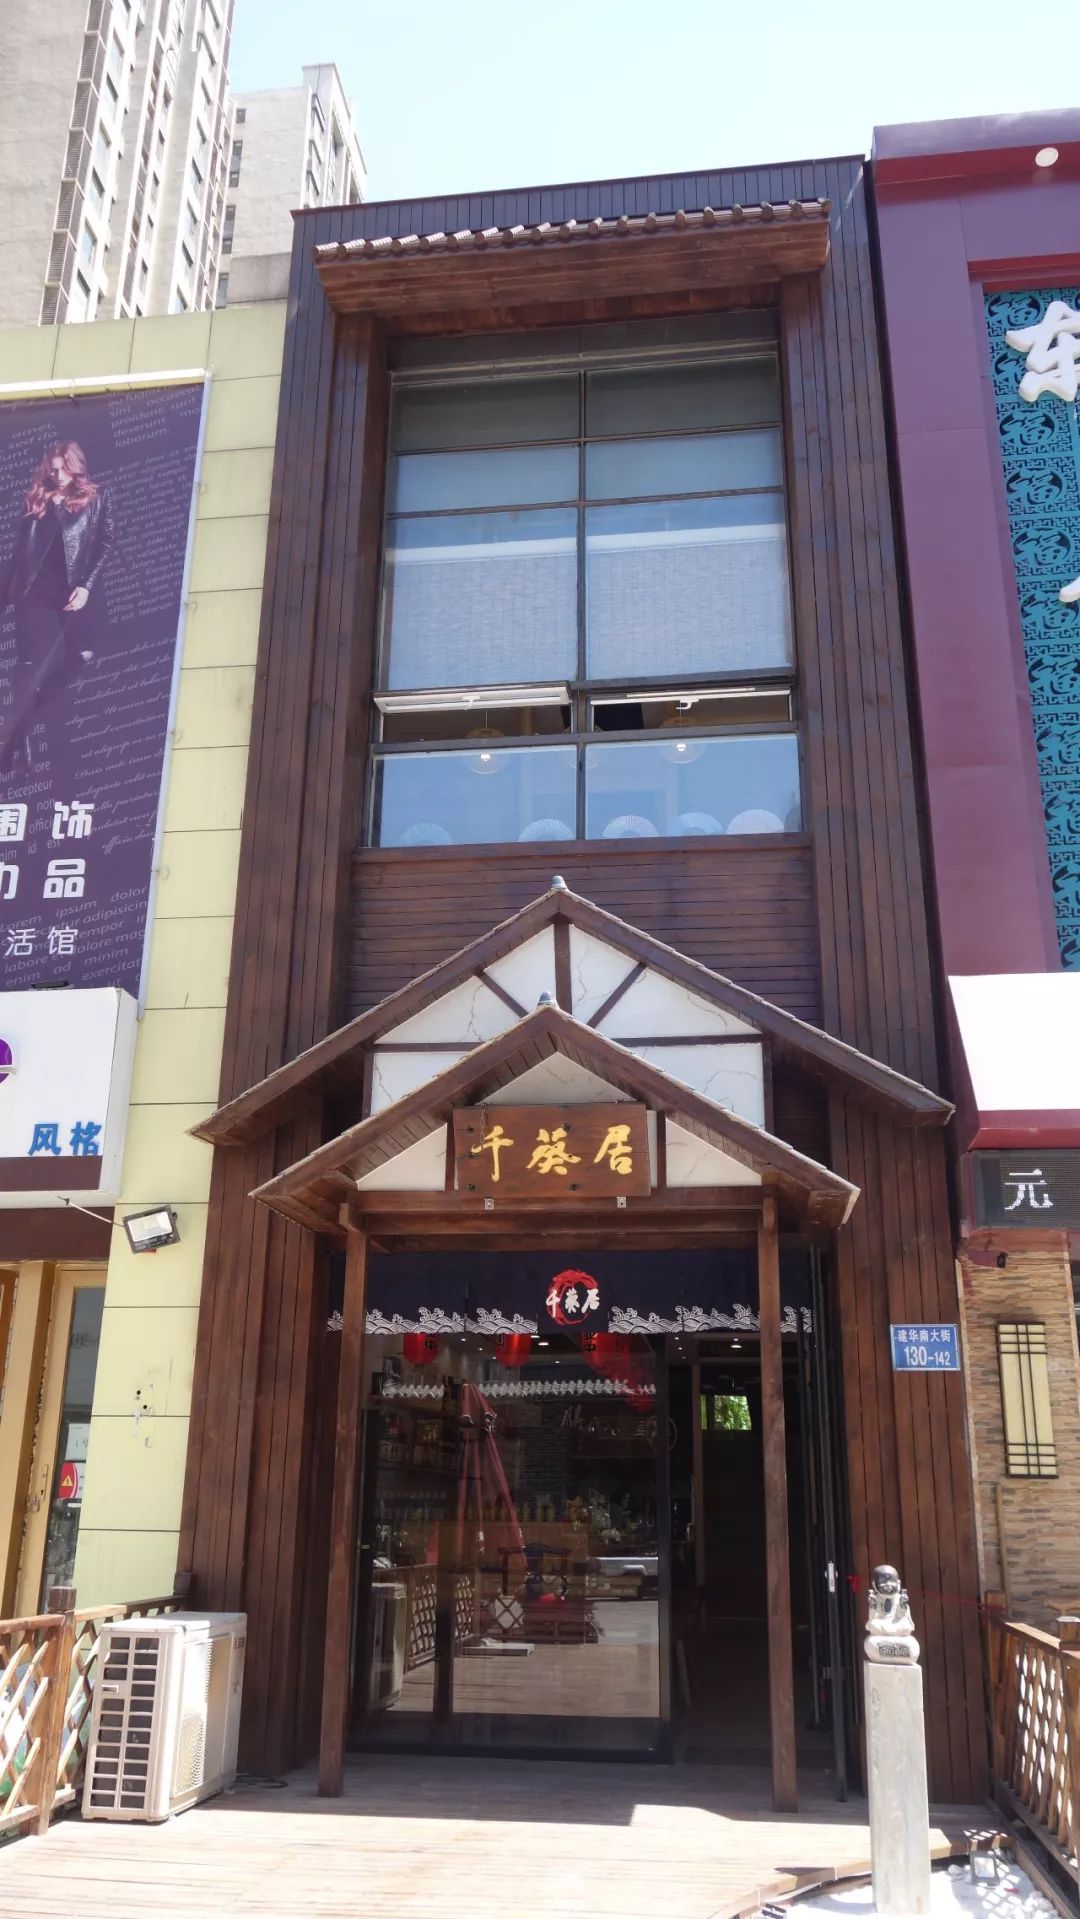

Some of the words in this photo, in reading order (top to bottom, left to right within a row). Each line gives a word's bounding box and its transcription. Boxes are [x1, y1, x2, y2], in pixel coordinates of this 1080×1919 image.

[5, 925, 79, 957] 活馆
[27, 1120, 104, 1157] 风格
[470, 1124, 634, 1183] 千葵居
[1003, 1167, 1054, 1211] 元
[895, 1328, 952, 1343] 建华南大街
[903, 1345, 952, 1367] 130-142
